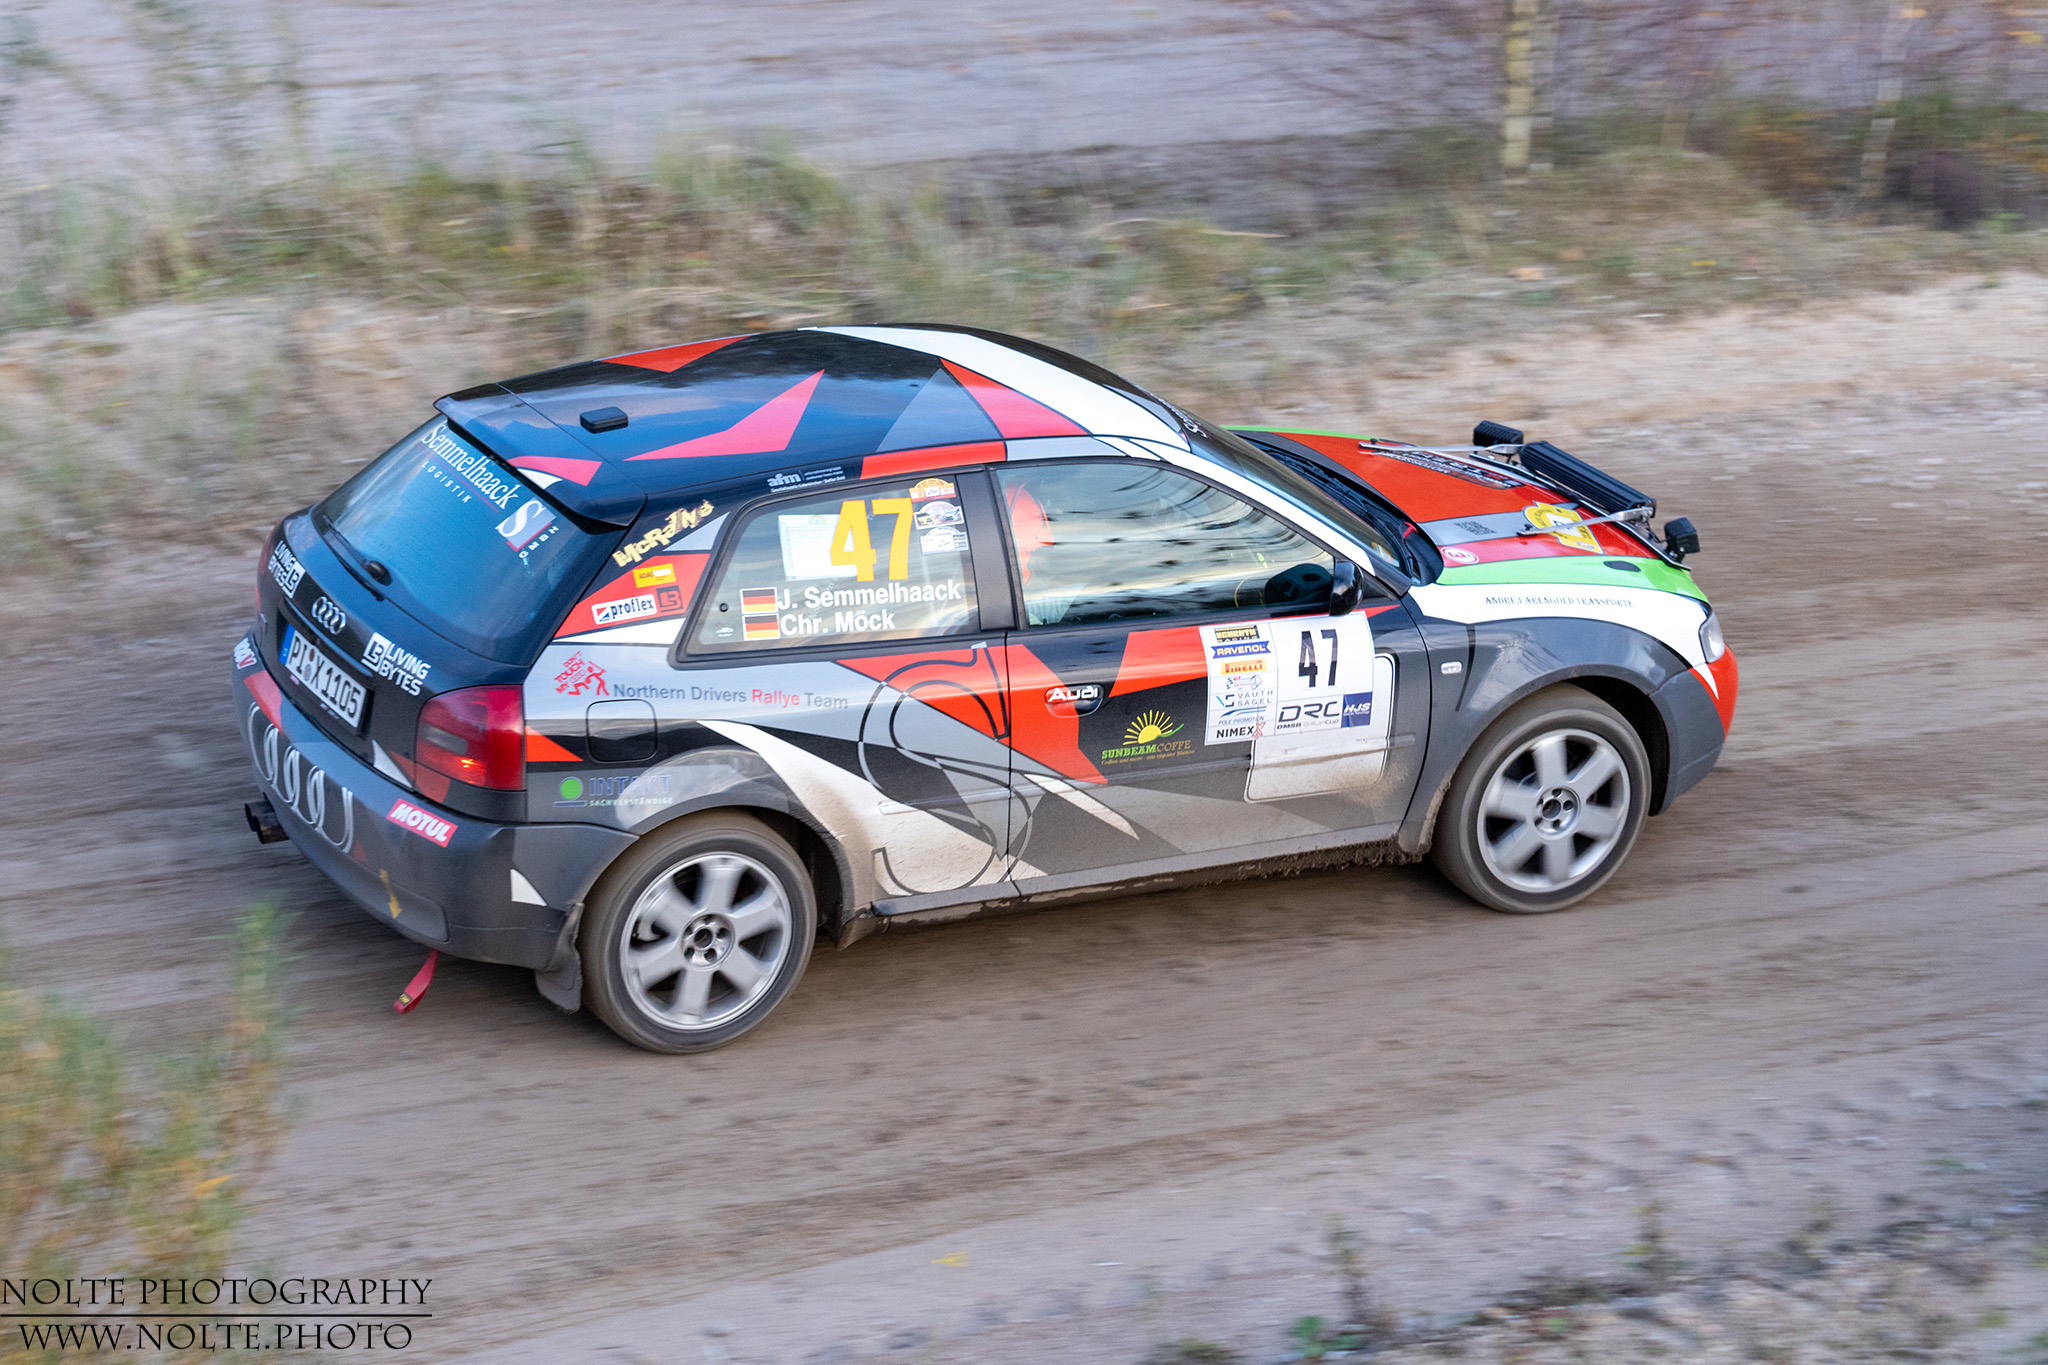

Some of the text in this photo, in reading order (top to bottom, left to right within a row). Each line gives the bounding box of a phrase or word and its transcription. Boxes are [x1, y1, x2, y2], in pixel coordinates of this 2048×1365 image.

[422, 424, 521, 509] Semmelhaack
[421, 461, 472, 503] LOGISTIK
[830, 498, 914, 582] 47
[777, 580, 962, 610] J. Semmelhaack
[1576, 597, 1633, 607] TRANSPORTE
[610, 597, 654, 619] proflex
[780, 610, 895, 635] Chr. Möck
[384, 643, 431, 680] LIVING
[1216, 644, 1266, 656] RAVENOL
[1299, 629, 1338, 688] 47
[378, 660, 423, 696] BYTES
[554, 659, 585, 683] TOUCH
[1225, 660, 1263, 674] PIRELLI
[614, 684, 848, 709] Northern Drivers Rallye Team
[1238, 690, 1273, 699] VAUTH
[1238, 698, 1272, 706] SAGEL
[1278, 701, 1340, 722] DRC
[1344, 703, 1371, 713] HJS
[589, 775, 672, 796] INTAKT
[390, 803, 451, 842] MOTUL
